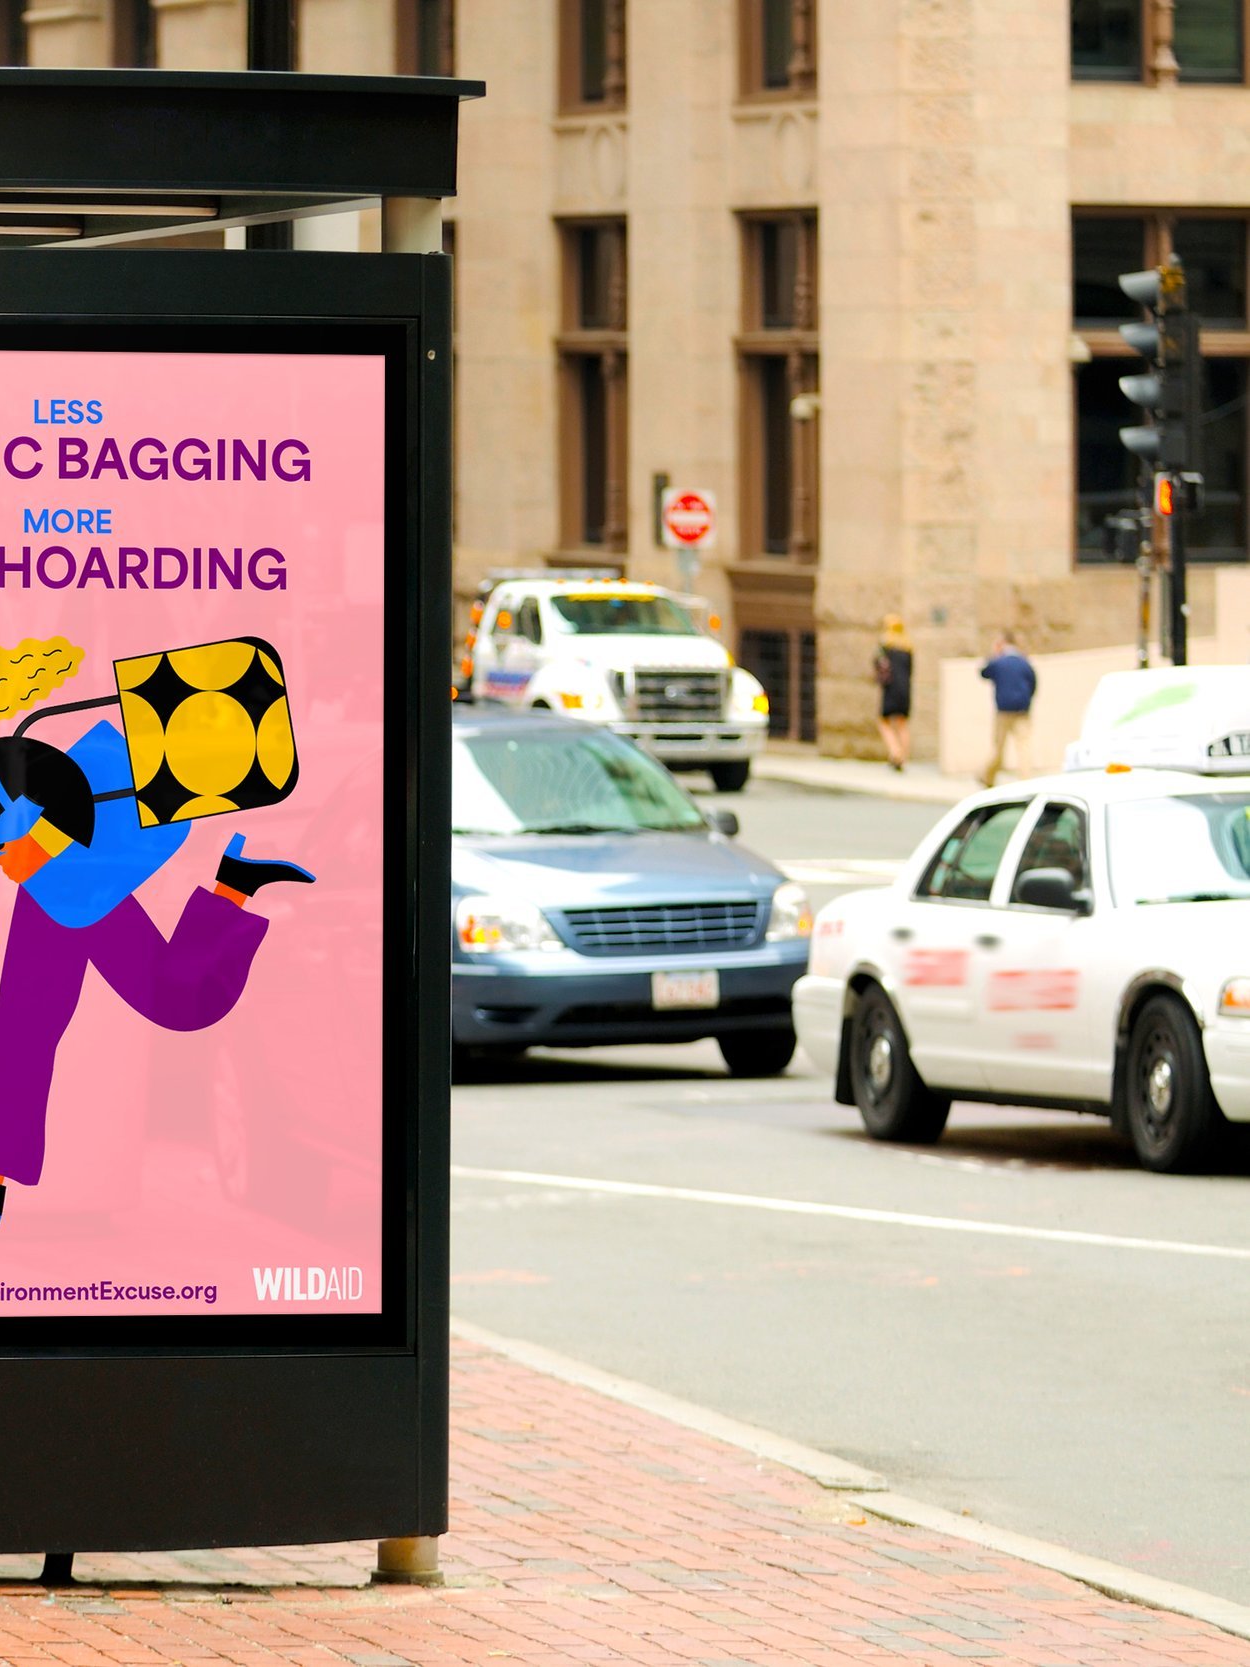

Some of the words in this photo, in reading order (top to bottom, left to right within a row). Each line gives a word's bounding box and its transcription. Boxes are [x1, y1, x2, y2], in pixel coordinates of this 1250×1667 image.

[33, 399, 103, 425] LESS
[58, 437, 311, 482] BAGGING
[23, 508, 112, 534] MORE
[252, 1266, 363, 1301] WILDAID
